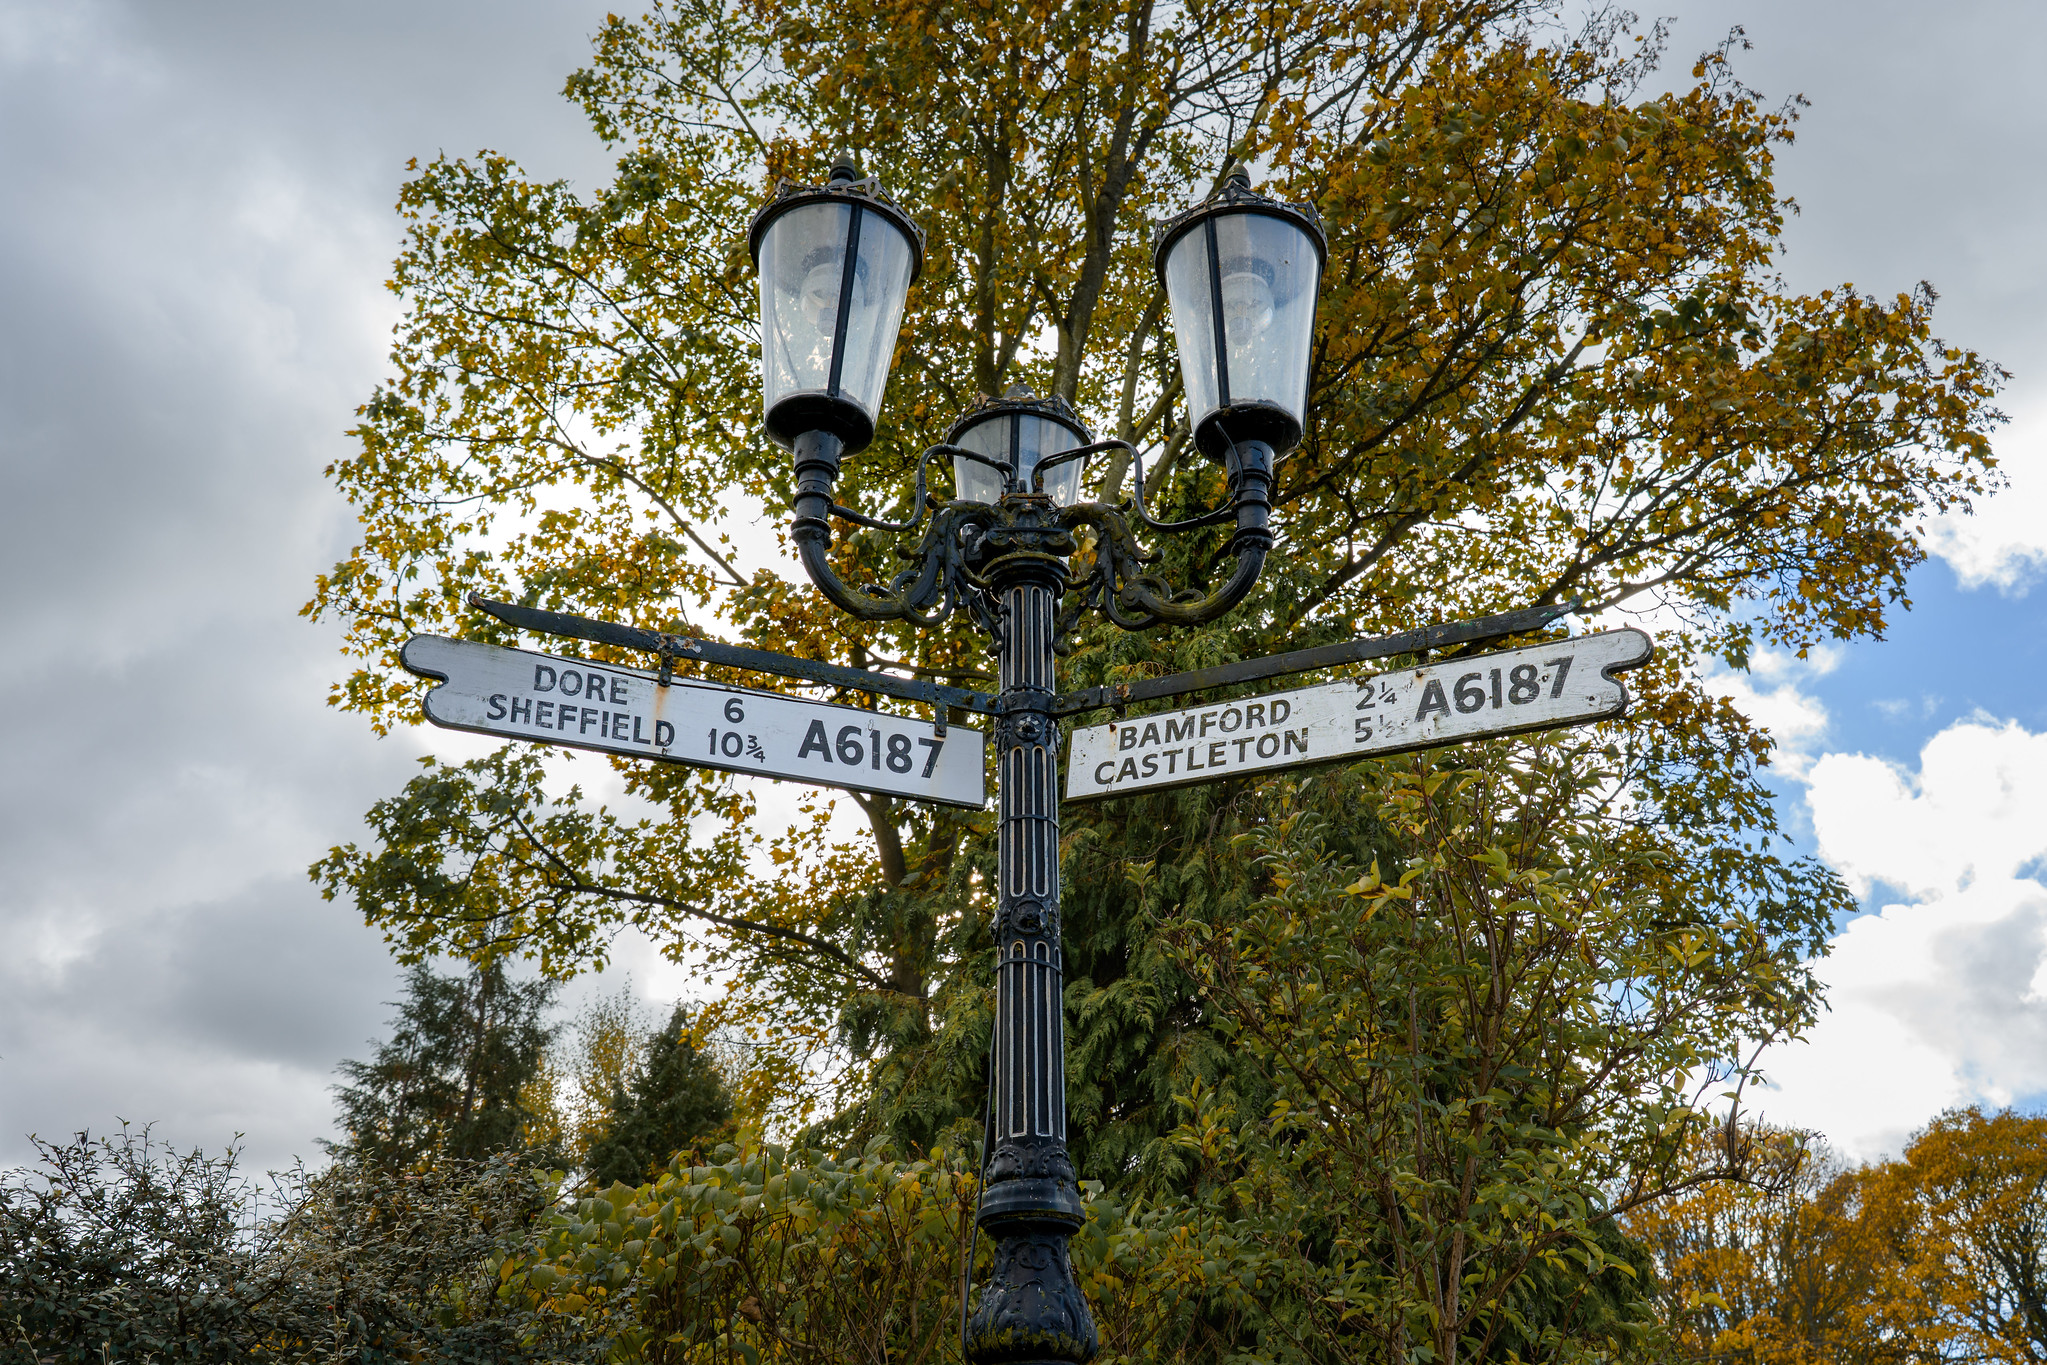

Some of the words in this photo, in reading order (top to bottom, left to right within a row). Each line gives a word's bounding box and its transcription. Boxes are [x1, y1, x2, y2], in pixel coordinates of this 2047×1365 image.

[534, 664, 629, 705] DORE
[724, 698, 746, 724] 6
[1415, 656, 1575, 721] A6187
[486, 694, 676, 747] SHEFFIELD
[798, 719, 943, 779] A6187
[1119, 699, 1291, 752] BAMFORD
[1094, 728, 1309, 786] CASTLETON
